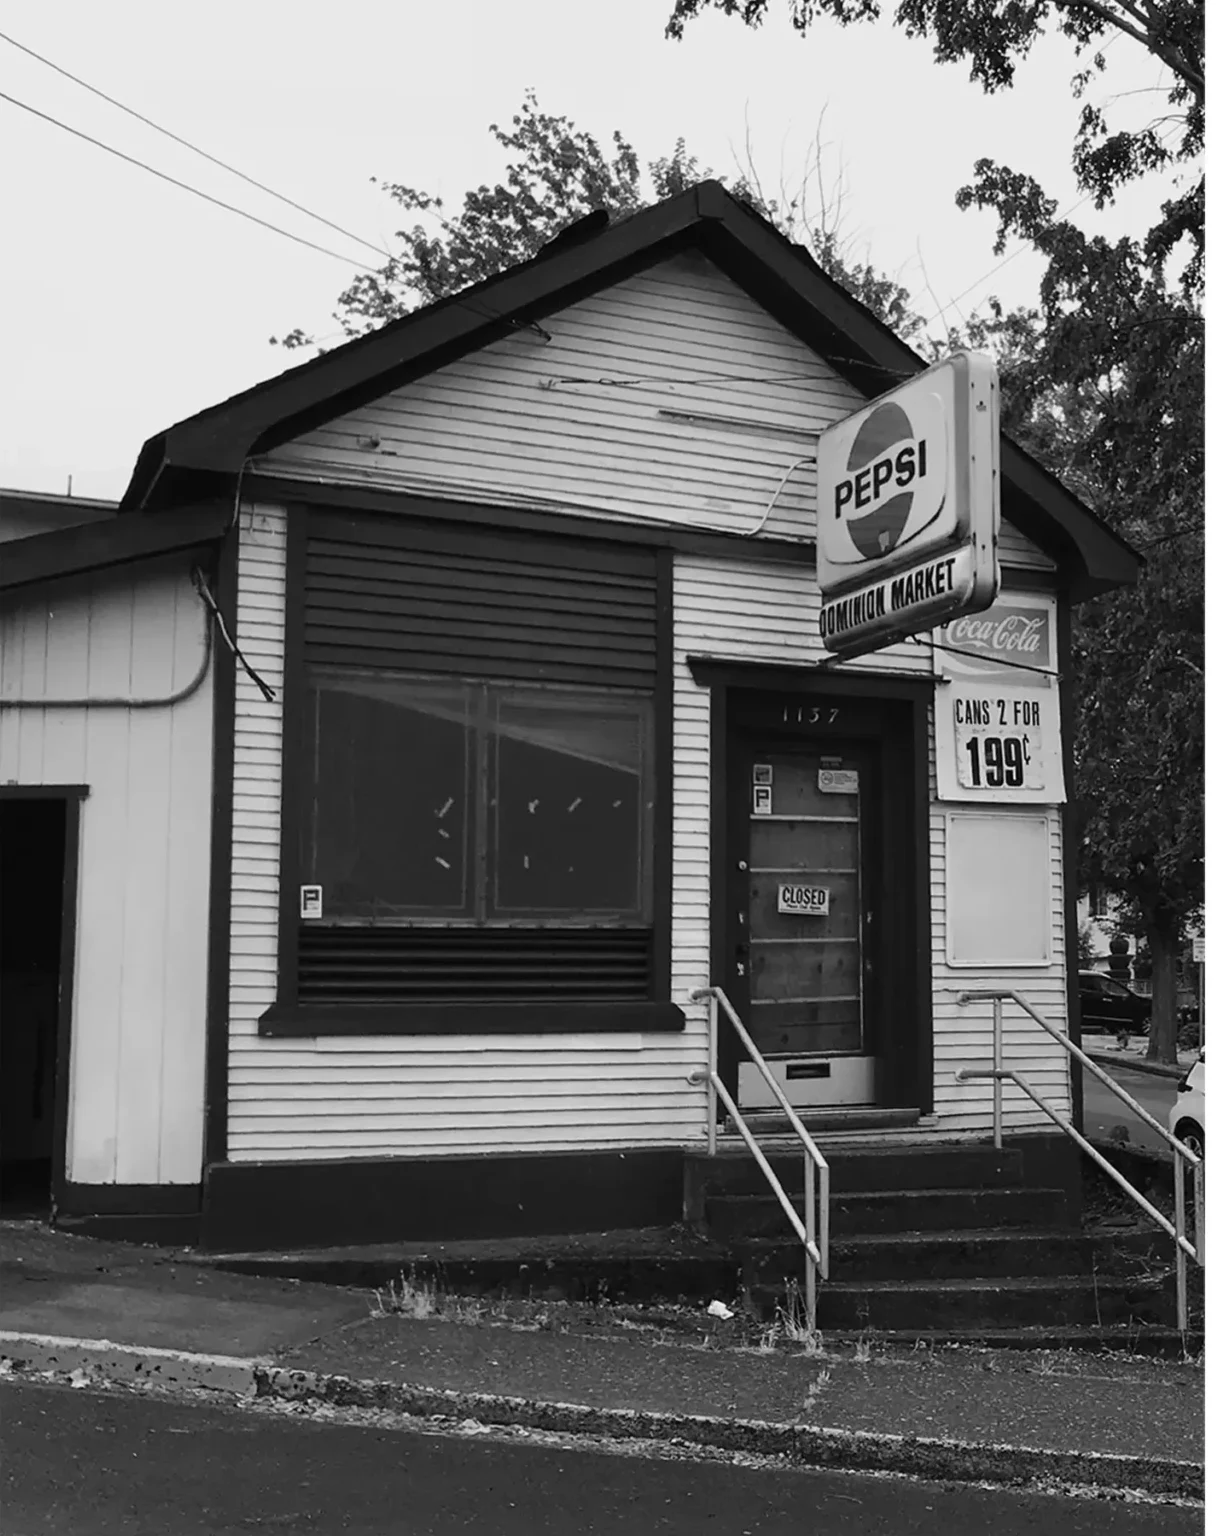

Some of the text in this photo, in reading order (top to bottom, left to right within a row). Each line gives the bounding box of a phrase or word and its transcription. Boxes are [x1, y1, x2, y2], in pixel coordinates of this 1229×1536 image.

[834, 439, 927, 519] PEPSI
[819, 557, 956, 638] DOMINION MARKET
[946, 615, 1045, 652] Coca-Cola
[783, 706, 839, 723] 1137
[956, 698, 1040, 726] CANS 2 FOR
[782, 887, 826, 905] CLOSED
